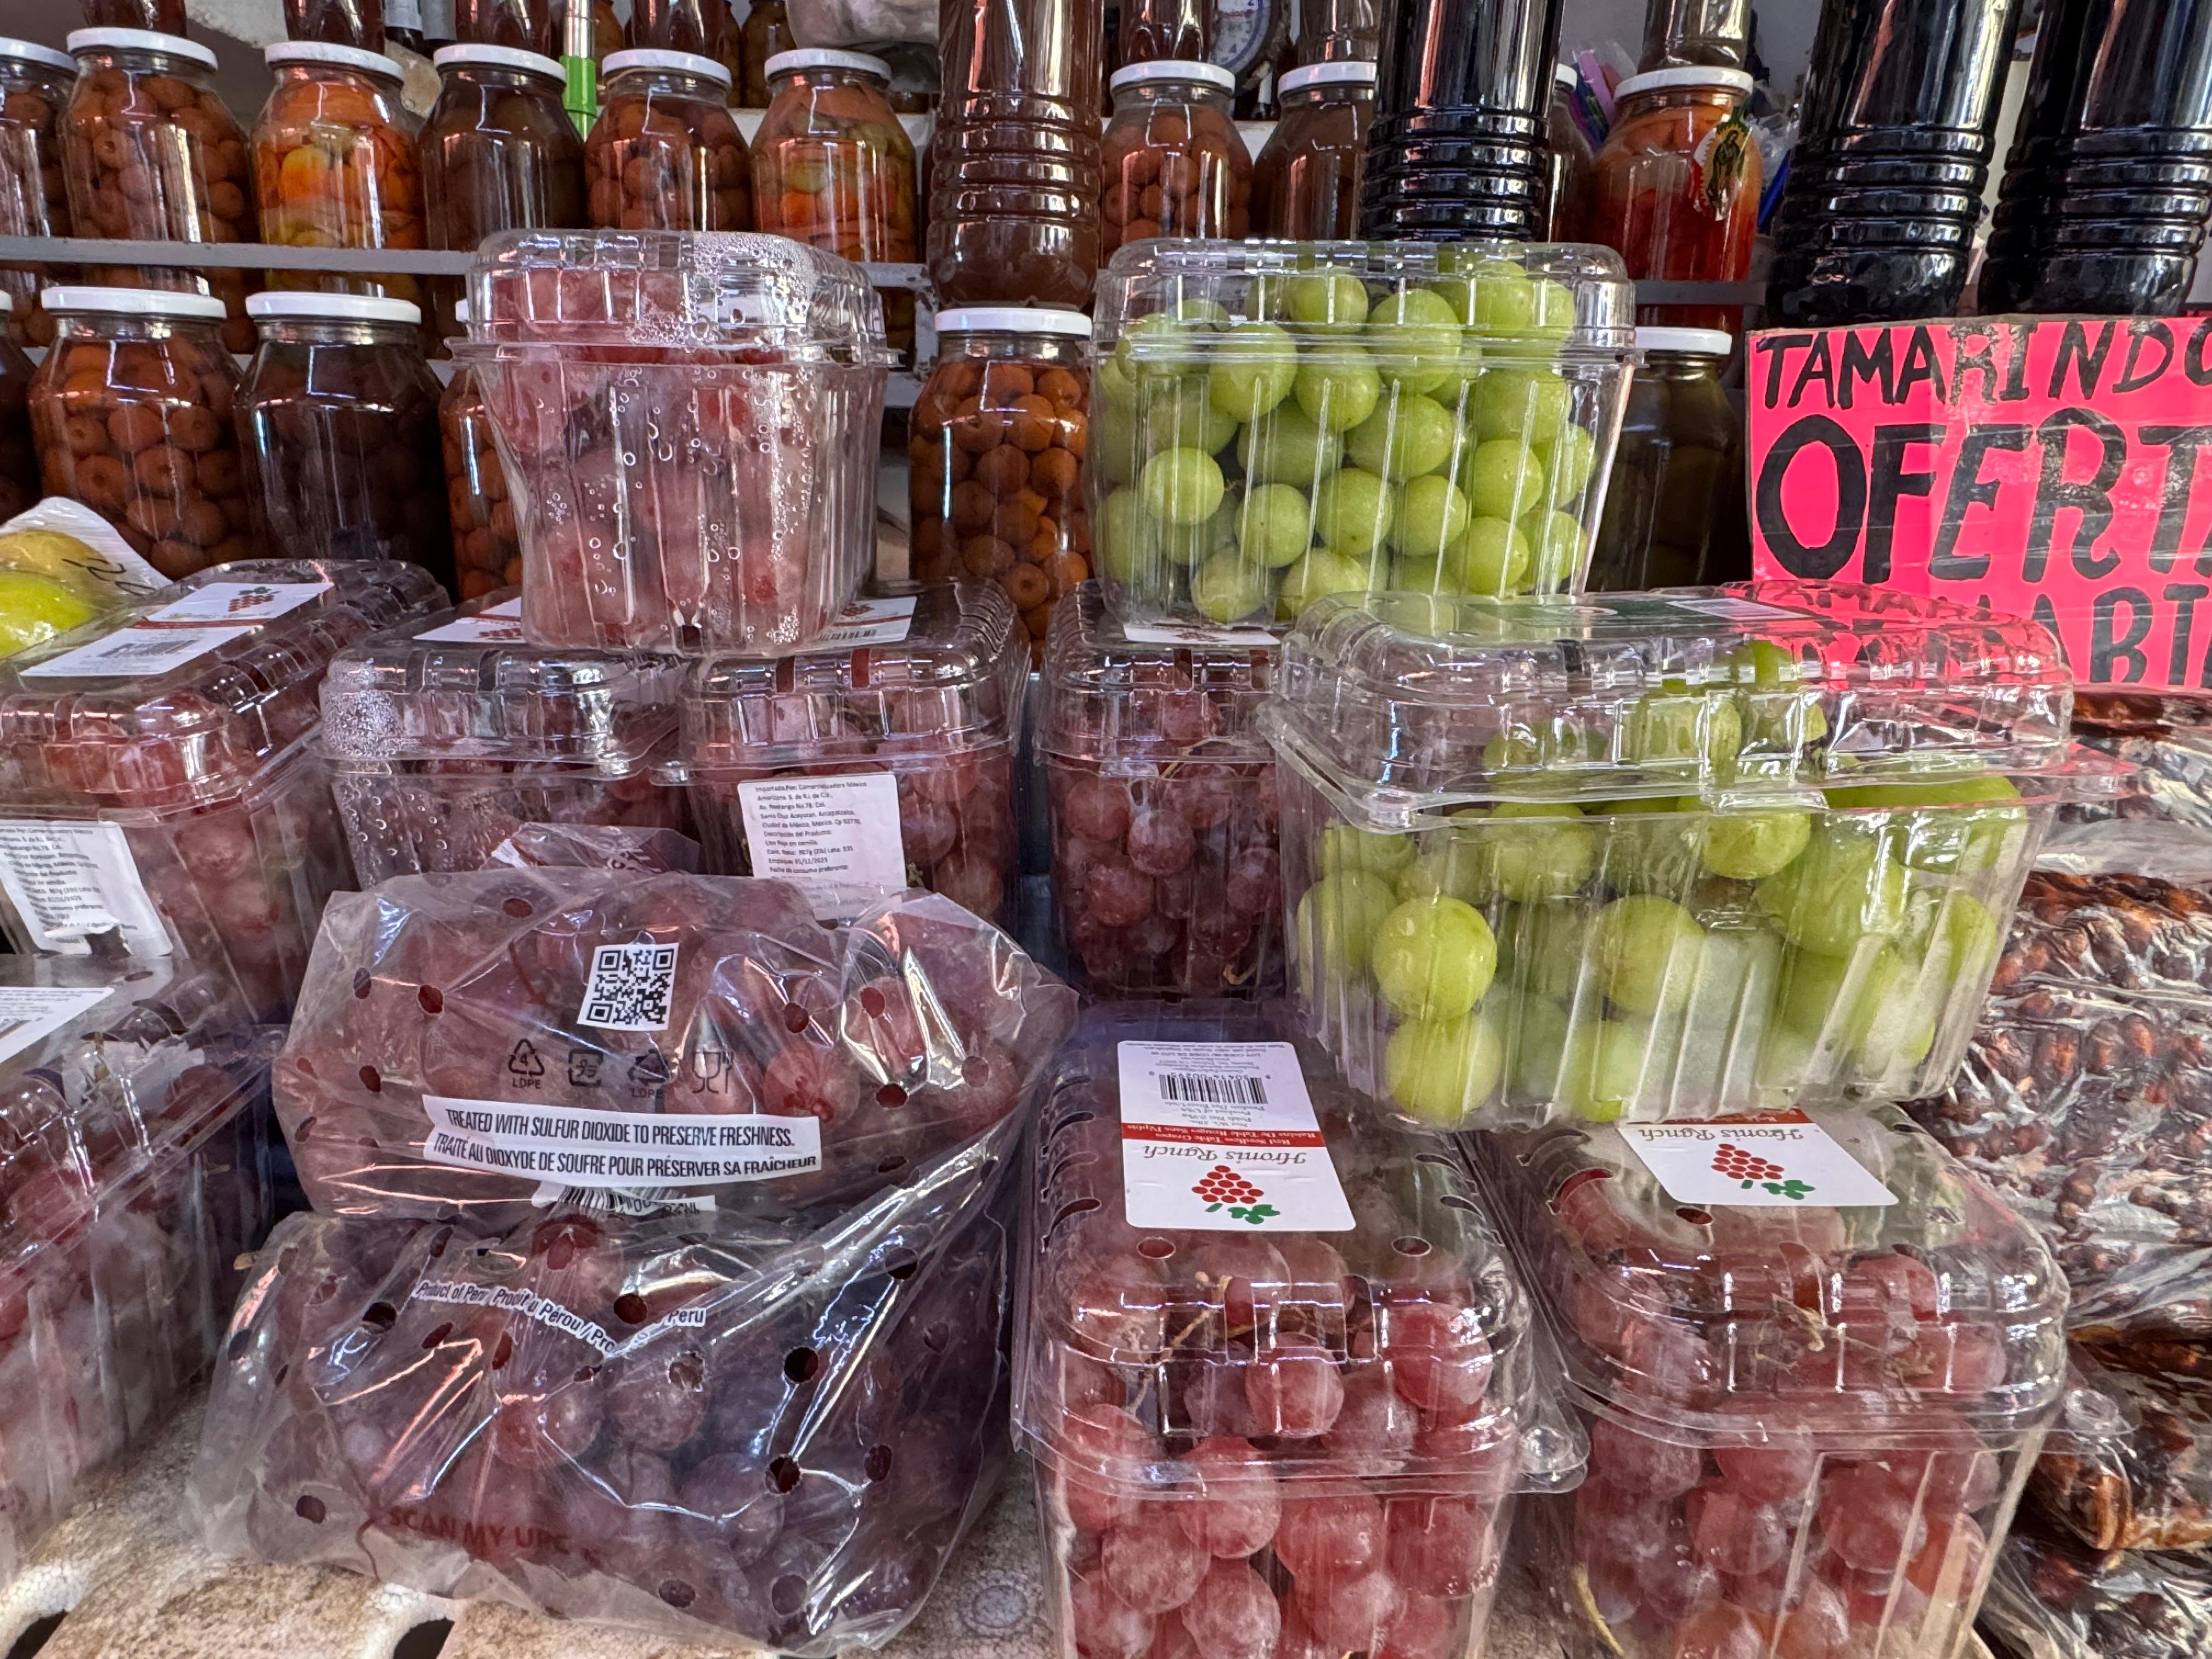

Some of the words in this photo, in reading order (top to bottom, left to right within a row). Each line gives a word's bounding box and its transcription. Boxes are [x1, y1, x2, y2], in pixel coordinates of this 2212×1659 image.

[1757, 408, 2212, 583] OFERT
[512, 1077, 542, 1090] LDPE
[445, 1108, 493, 1132] TREATED
[495, 1113, 529, 1136] WITH
[531, 1117, 579, 1139] SULFUR
[582, 1120, 630, 1143] DIOXIDE
[633, 1124, 649, 1144] TO
[652, 1126, 717, 1147] PRESERVE
[719, 1126, 795, 1147] FRESHNESS.
[1639, 1127, 1716, 1141] Ranch
[1720, 1128, 1804, 1141] Hronis
[433, 1132, 469, 1159] TRAITÉ
[469, 1142, 484, 1163] AU
[485, 1146, 536, 1170] DIOXYDE
[538, 1152, 556, 1172] DE
[557, 1153, 607, 1175] SOUFRE
[608, 1155, 644, 1177] POUR
[647, 1154, 720, 1178] PRÉSERVER
[723, 1161, 742, 1176] SA
[744, 1155, 817, 1176] FRAÎCHEUR
[1142, 1144, 1218, 1161] Ranch
[1225, 1151, 1307, 1165] Hronis
[538, 1301, 583, 1331] Pérou
